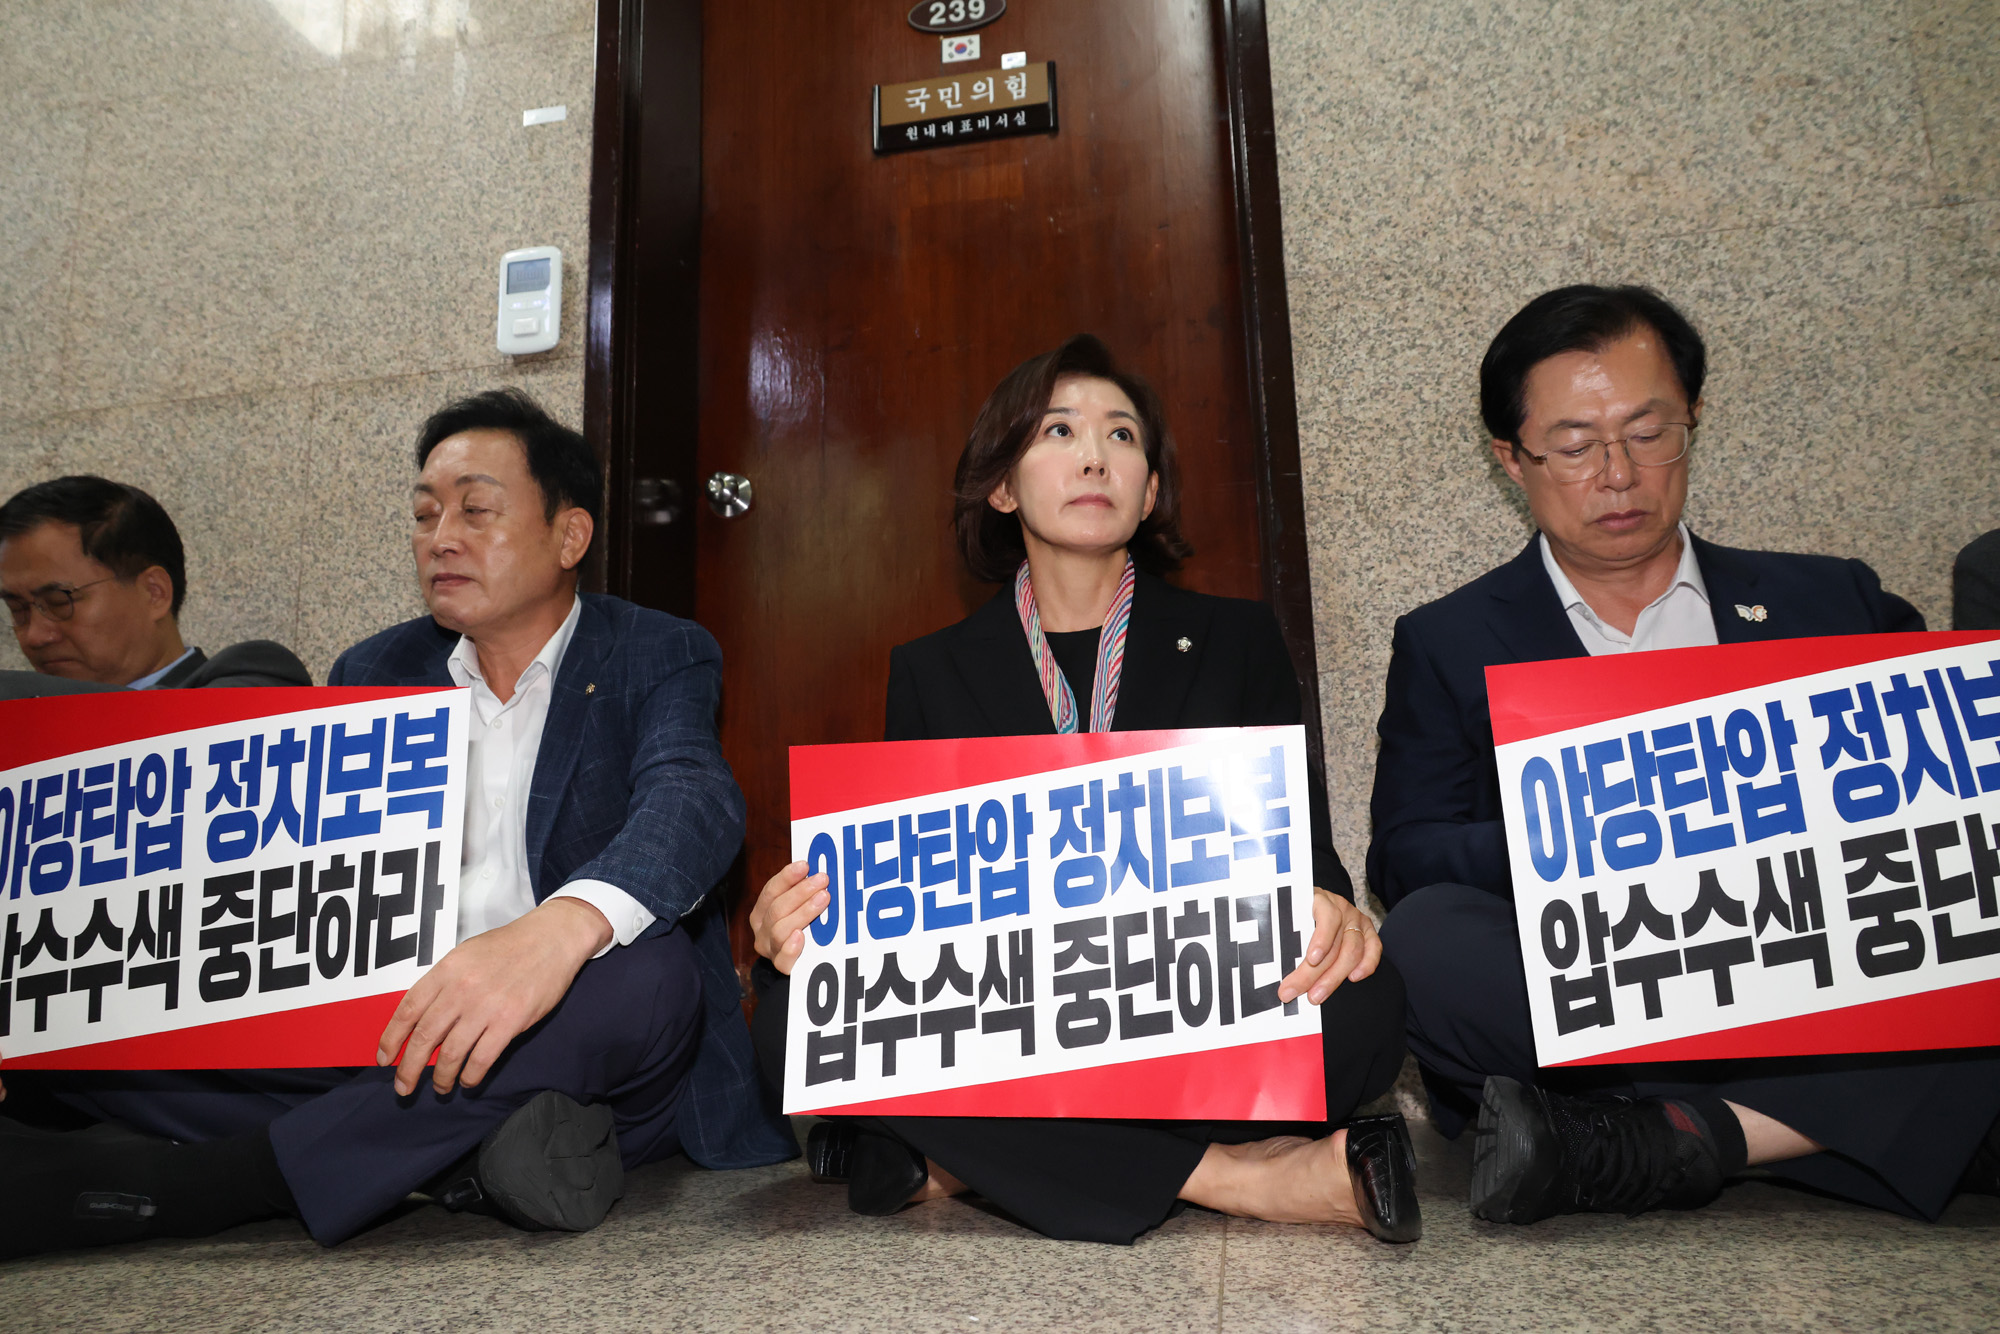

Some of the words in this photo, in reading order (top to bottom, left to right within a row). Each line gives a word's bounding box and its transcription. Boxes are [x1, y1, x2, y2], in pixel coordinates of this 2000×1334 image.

[904, 72, 1027, 114] 국민의힘
[929, 0, 986, 26] 239
[905, 110, 1027, 141] 원내대표비서실
[0, 747, 192, 900] 야당탄압
[205, 707, 450, 863] 정치보복
[807, 793, 1034, 948] 야당탄압
[1048, 745, 1292, 909] 정치보복
[1520, 700, 1808, 882] 야당탄압
[198, 841, 445, 1003] 중단하라
[805, 927, 1036, 1087] 압수수색
[1053, 886, 1302, 1050] 중단하라
[1540, 847, 1834, 1036] 압수수색
[1840, 813, 2000, 979] 중단
